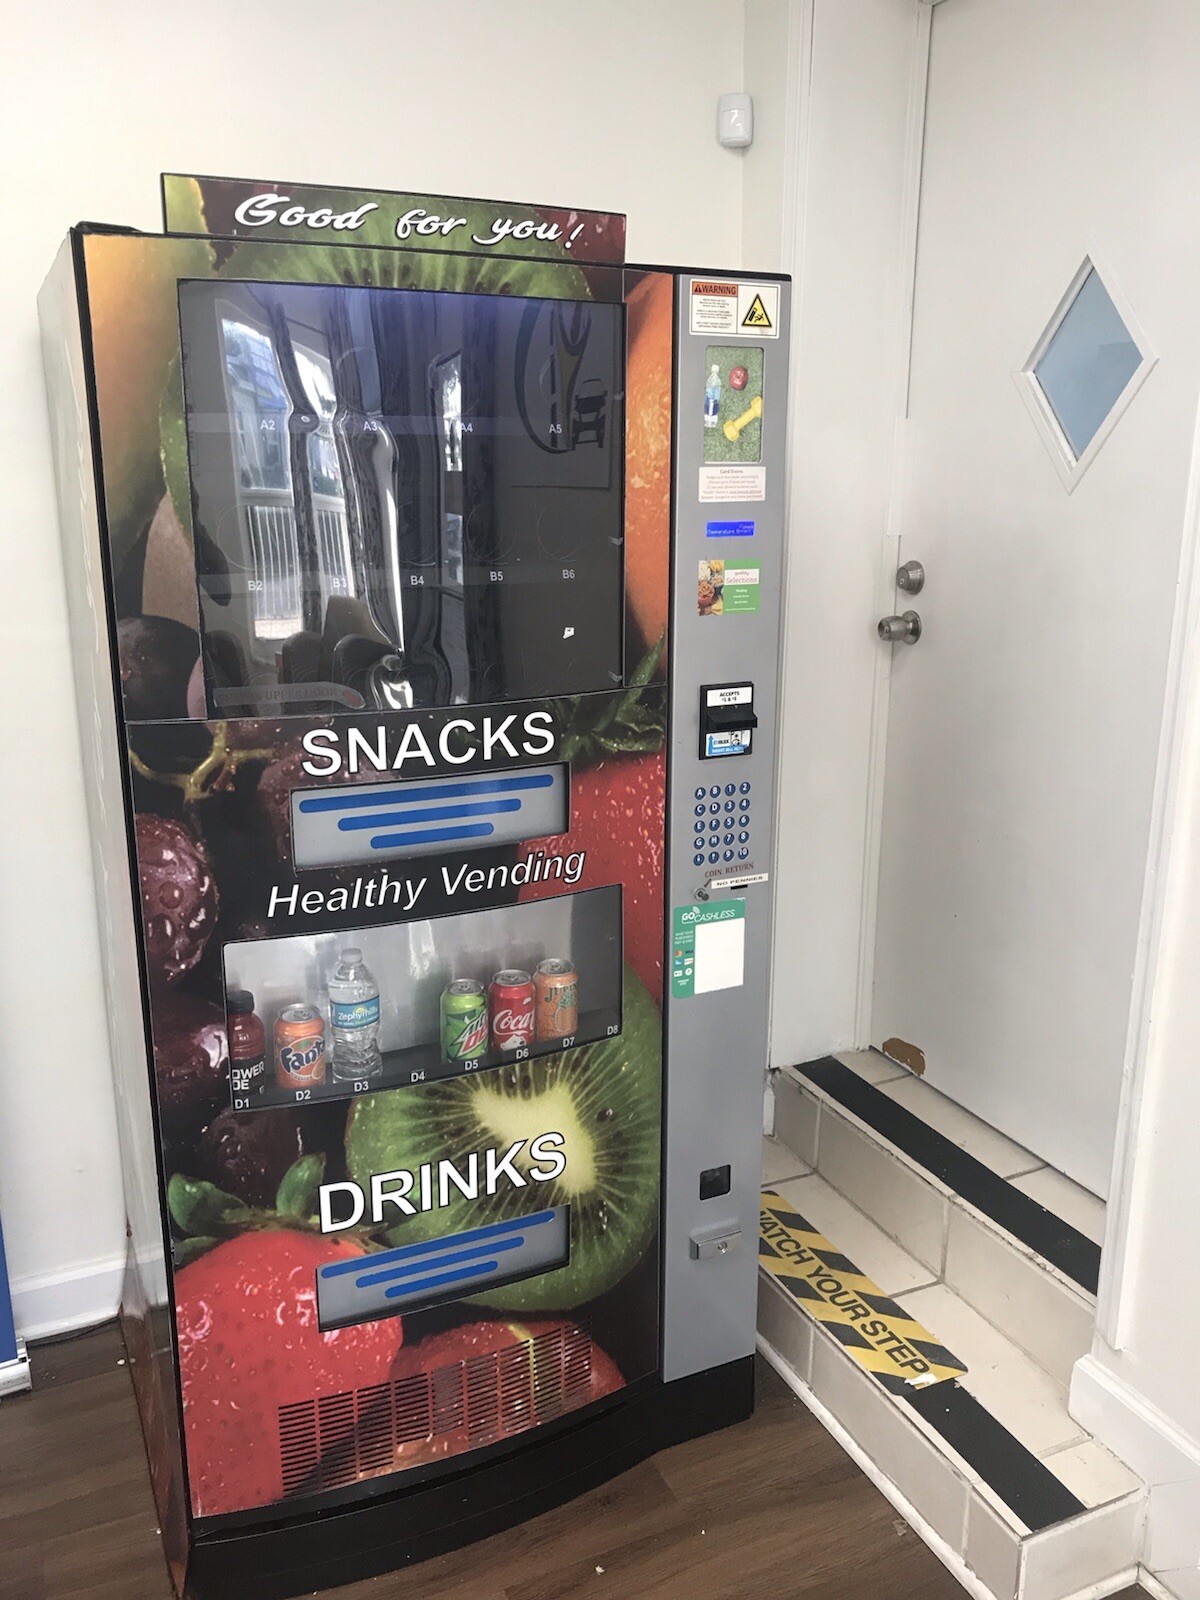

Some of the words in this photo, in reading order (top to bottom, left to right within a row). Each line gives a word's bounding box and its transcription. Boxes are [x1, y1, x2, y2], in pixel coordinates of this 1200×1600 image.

[234, 194, 378, 231] Good
[395, 208, 466, 240] for
[472, 216, 584, 249] you!
[702, 284, 736, 295] WARNING
[260, 420, 276, 431] A2
[363, 421, 378, 432] A3
[548, 424, 563, 434] A5
[248, 580, 263, 591] B2
[333, 577, 348, 588] B3
[410, 574, 425, 586] B4
[490, 571, 504, 582] B5
[562, 569, 576, 580] B6
[302, 711, 556, 776] SNACKS
[267, 874, 428, 918] Healthy
[441, 851, 587, 896] Vending
[705, 870, 722, 878] COIN
[725, 863, 754, 876] RETURN
[682, 912, 695, 920] GO
[694, 909, 736, 922] CASHLESS
[235, 1099, 250, 1109] D1
[296, 1090, 311, 1100] D2
[354, 1082, 369, 1092] D3
[411, 1071, 425, 1082] D4
[465, 1059, 479, 1070] D5
[516, 1049, 529, 1059] D6
[563, 1037, 575, 1048] D7
[607, 1025, 618, 1036] D8
[318, 1131, 568, 1234] DRINKS
[806, 1265, 871, 1322] YOUR
[860, 1320, 930, 1374] STEP
